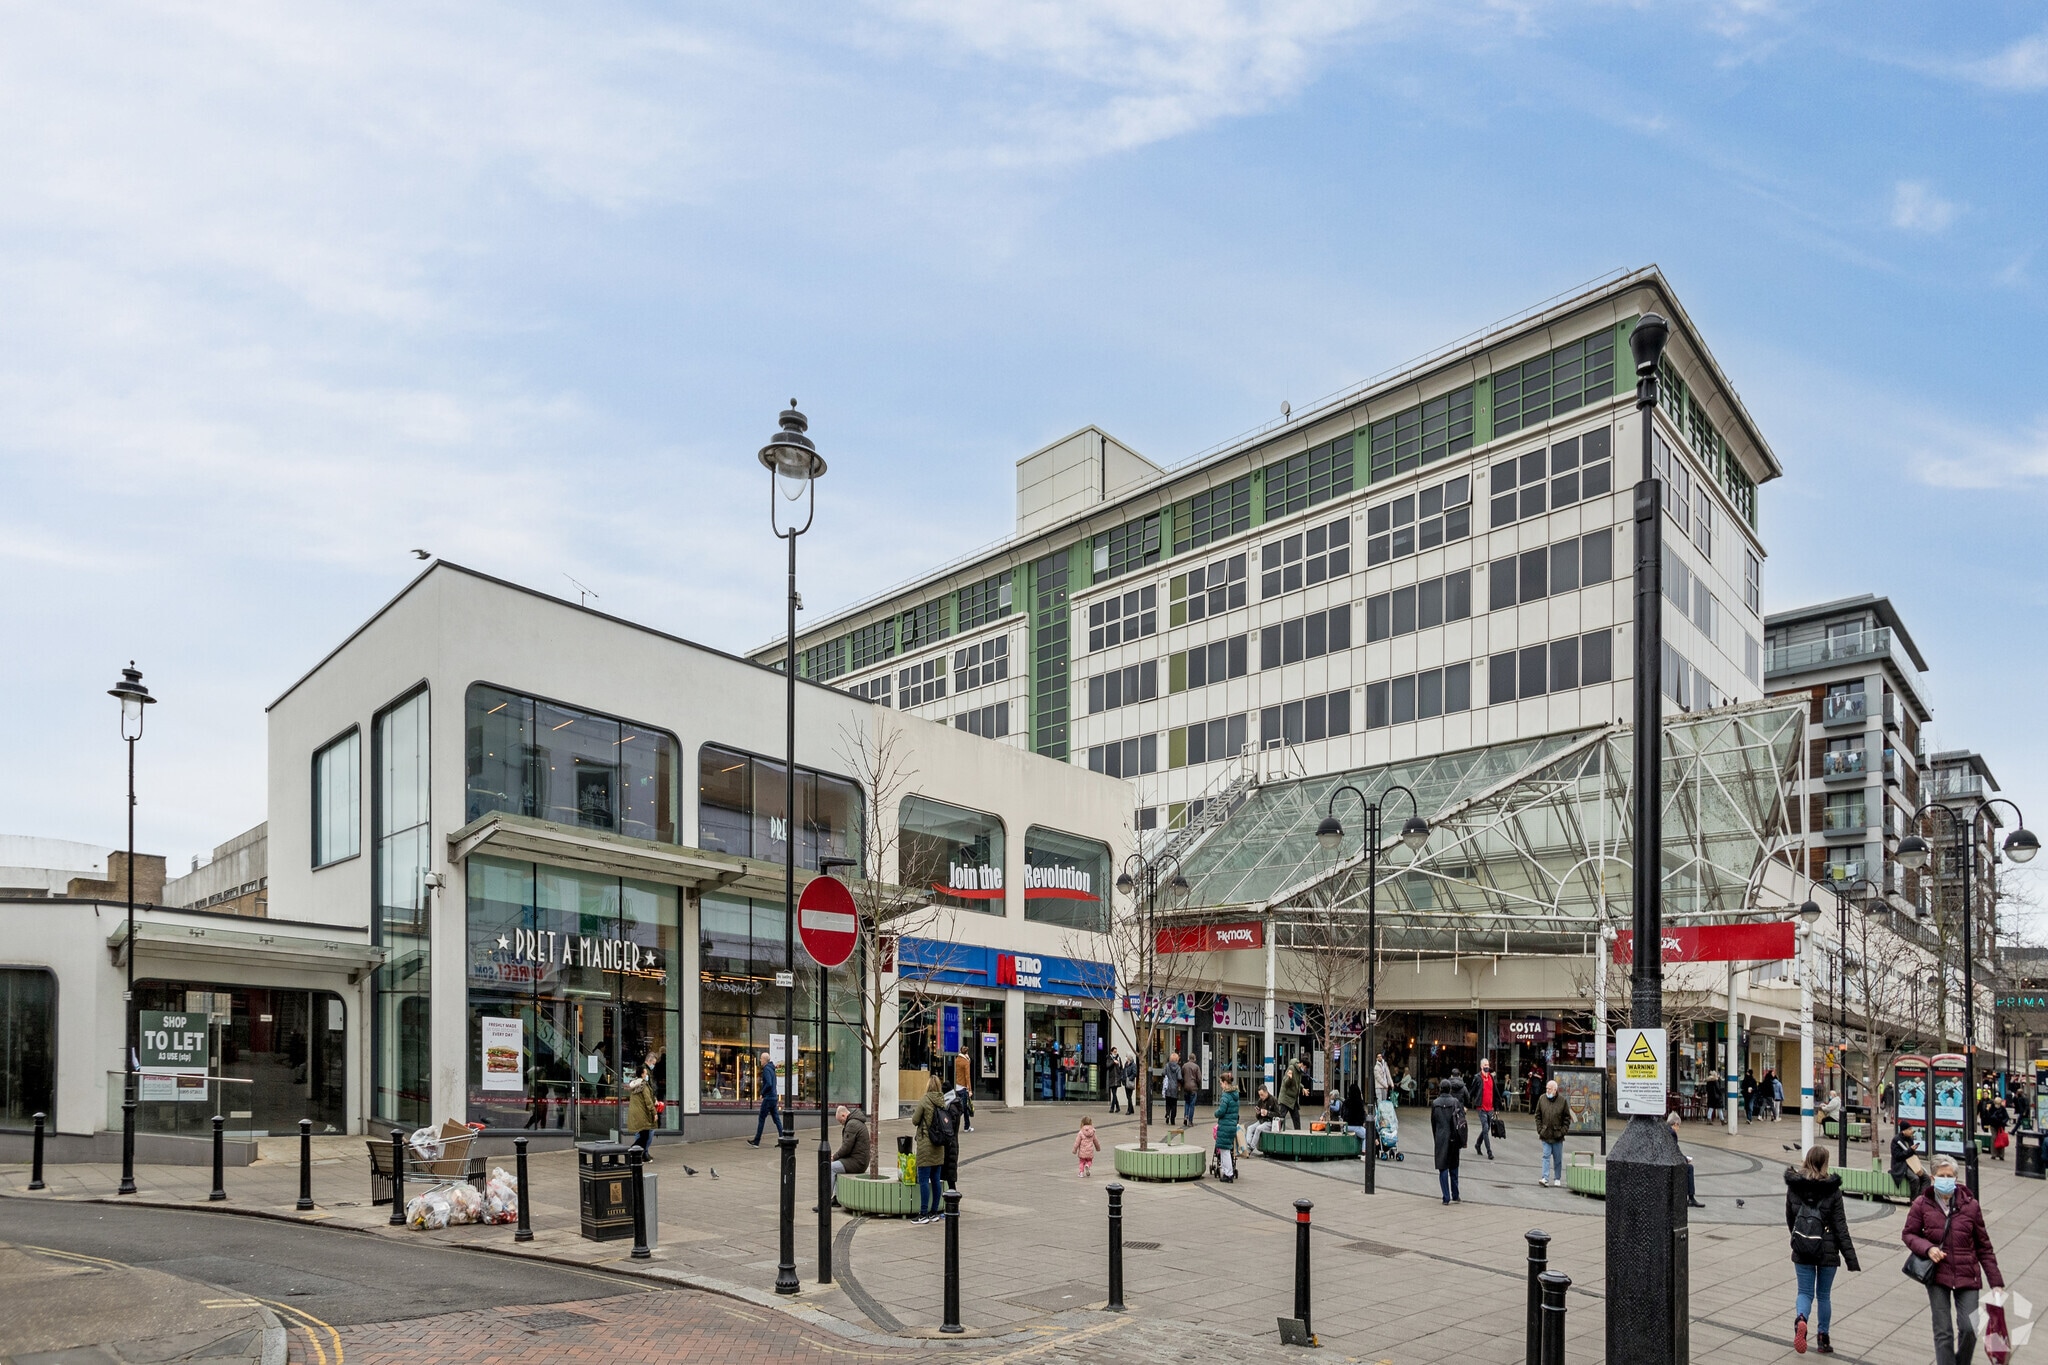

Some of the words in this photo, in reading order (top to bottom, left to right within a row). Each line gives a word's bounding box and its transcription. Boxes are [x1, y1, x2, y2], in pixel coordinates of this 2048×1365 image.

[949, 862, 978, 890] Join
[979, 863, 1003, 890] the
[1024, 863, 1091, 893] Revolution
[515, 927, 556, 963] PRET
[562, 934, 573, 965] A
[580, 937, 641, 972] MANGER
[997, 953, 1042, 986] METRO
[1016, 975, 1042, 988] BANK
[163, 1015, 187, 1028] SHOP
[1234, 1001, 1285, 1030] Pavilins
[1510, 1022, 1541, 1034] COSTA
[144, 1030, 169, 1050] TO
[173, 1031, 205, 1051] LET
[167, 1052, 178, 1060] USE
